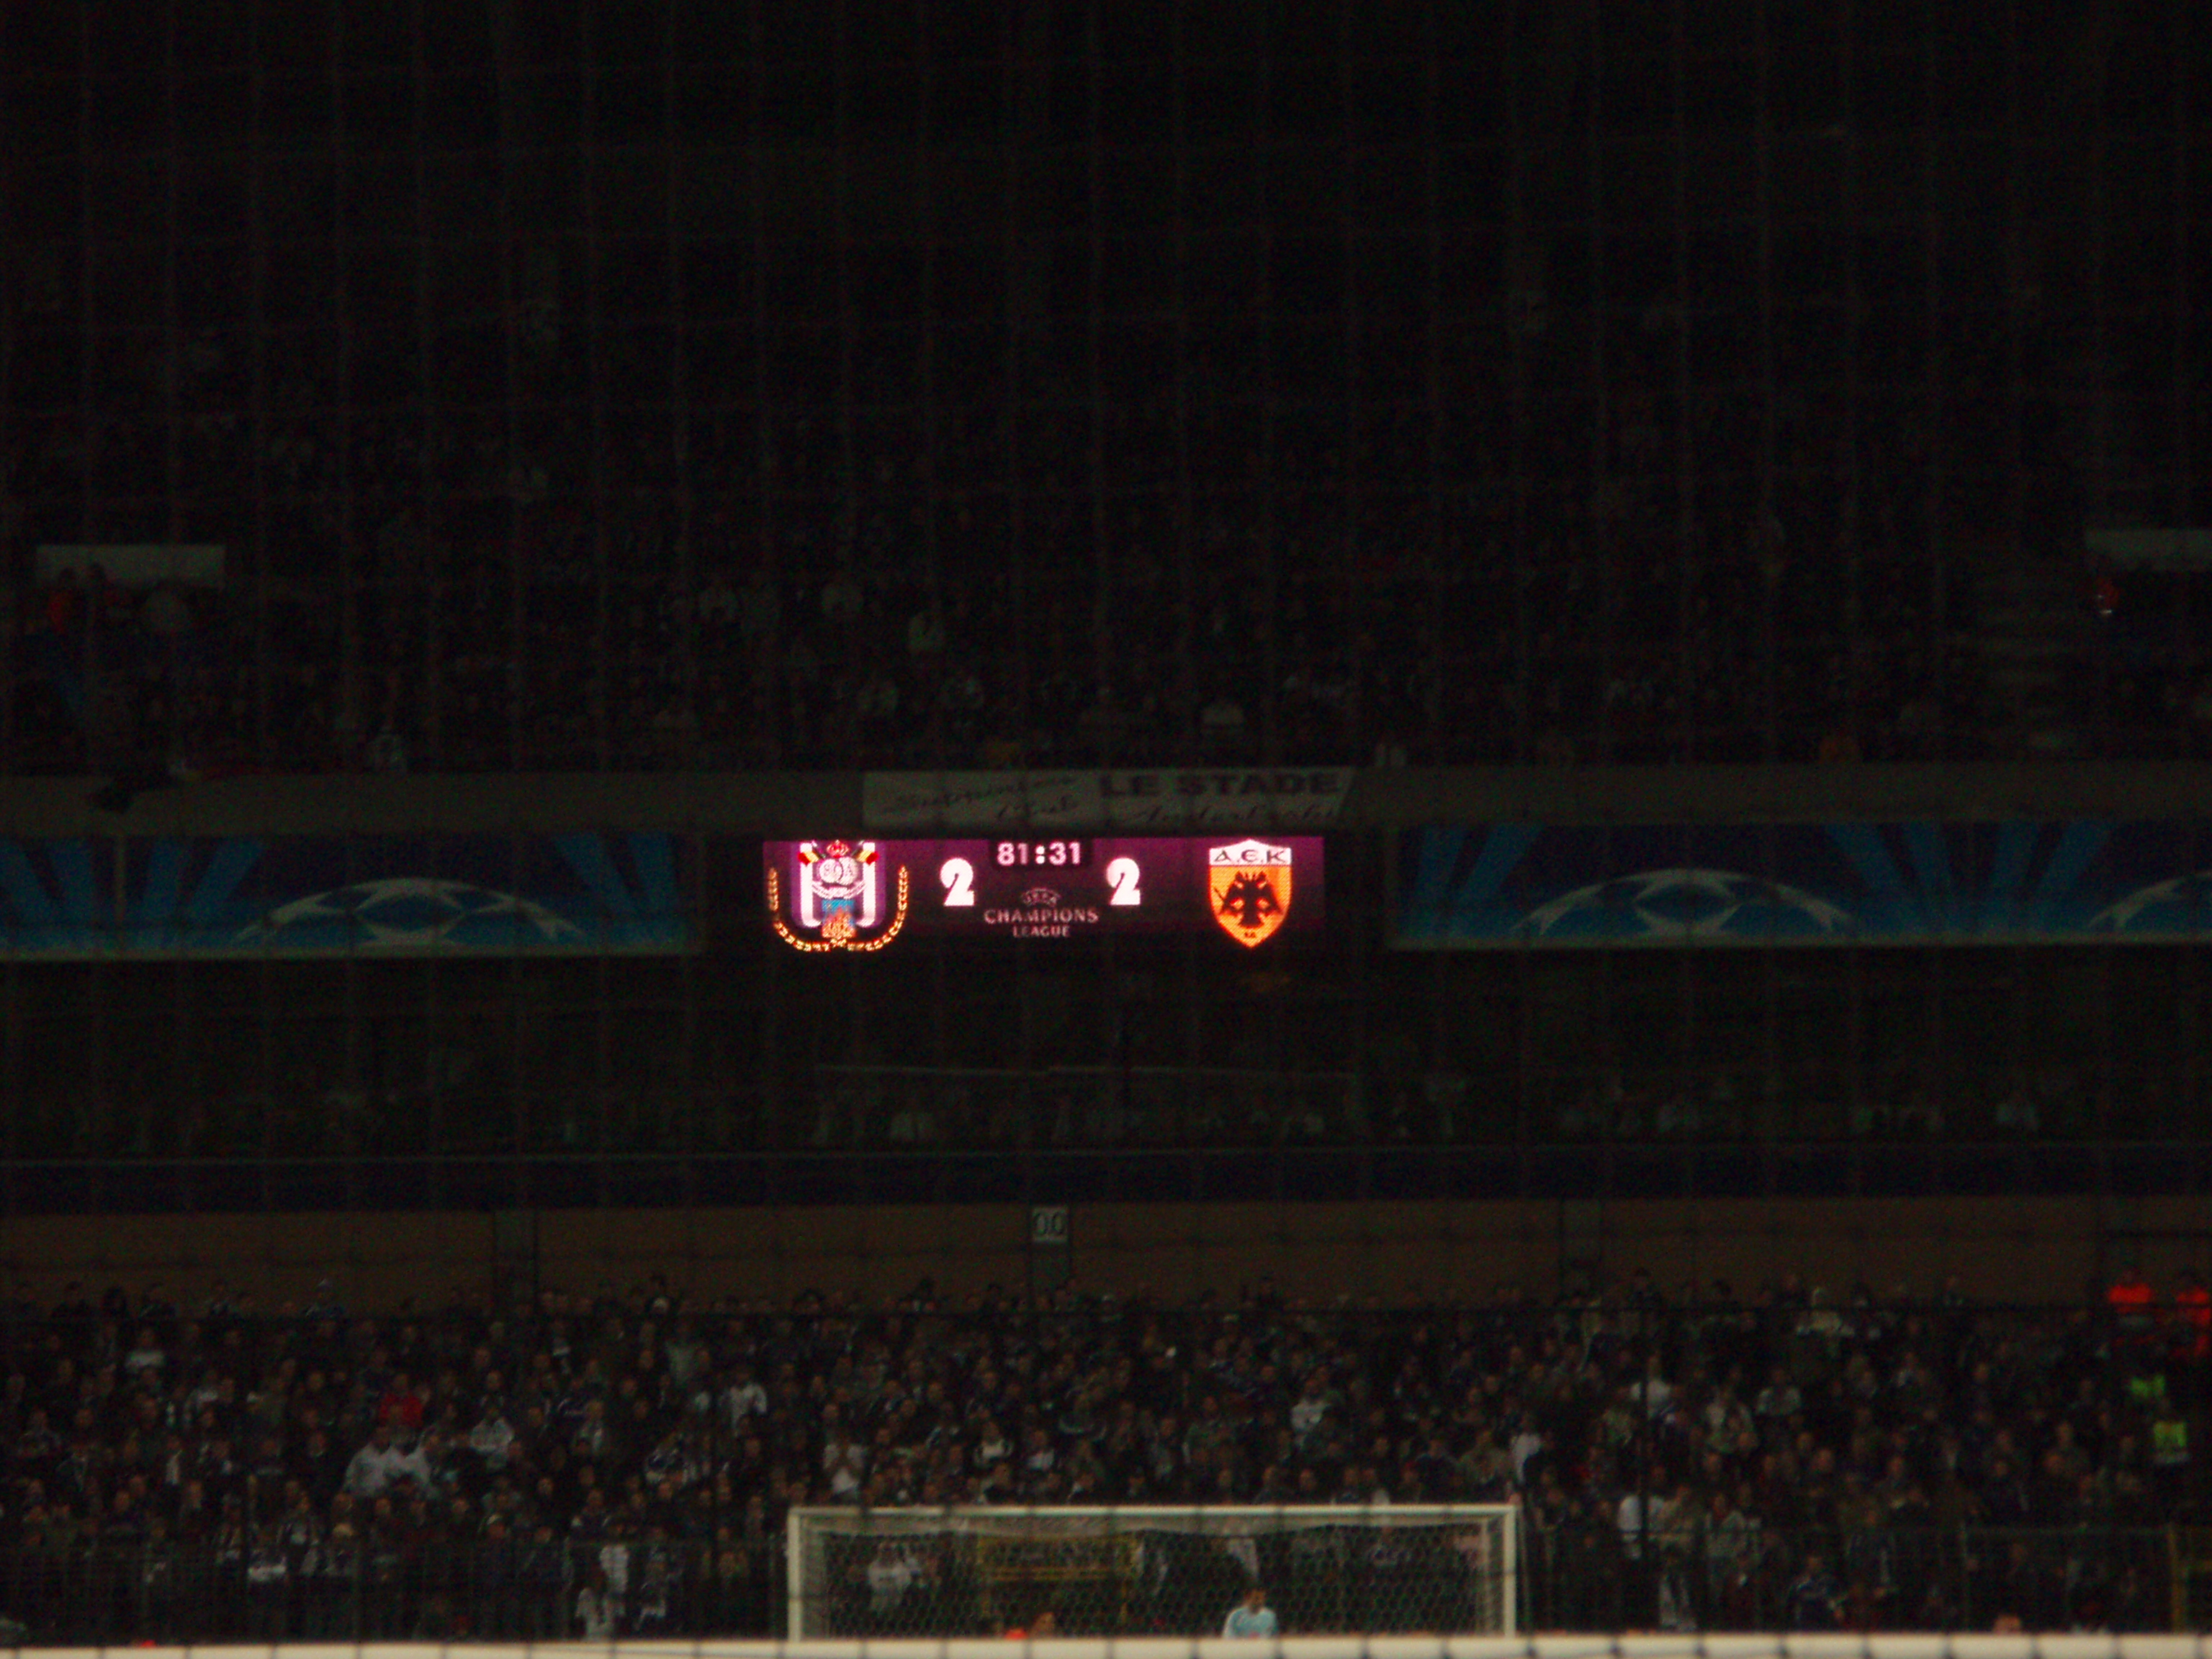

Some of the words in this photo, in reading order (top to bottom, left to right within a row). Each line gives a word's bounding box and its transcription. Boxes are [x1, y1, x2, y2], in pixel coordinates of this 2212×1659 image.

[1100, 773, 1161, 796] LE
[1177, 770, 1341, 795] STADE
[997, 841, 1080, 866] 81:31
[940, 858, 975, 907] 2
[1106, 857, 1141, 906] 2
[984, 908, 1100, 925] CHAMPIONS
[1012, 925, 1071, 938] LEAGUE
